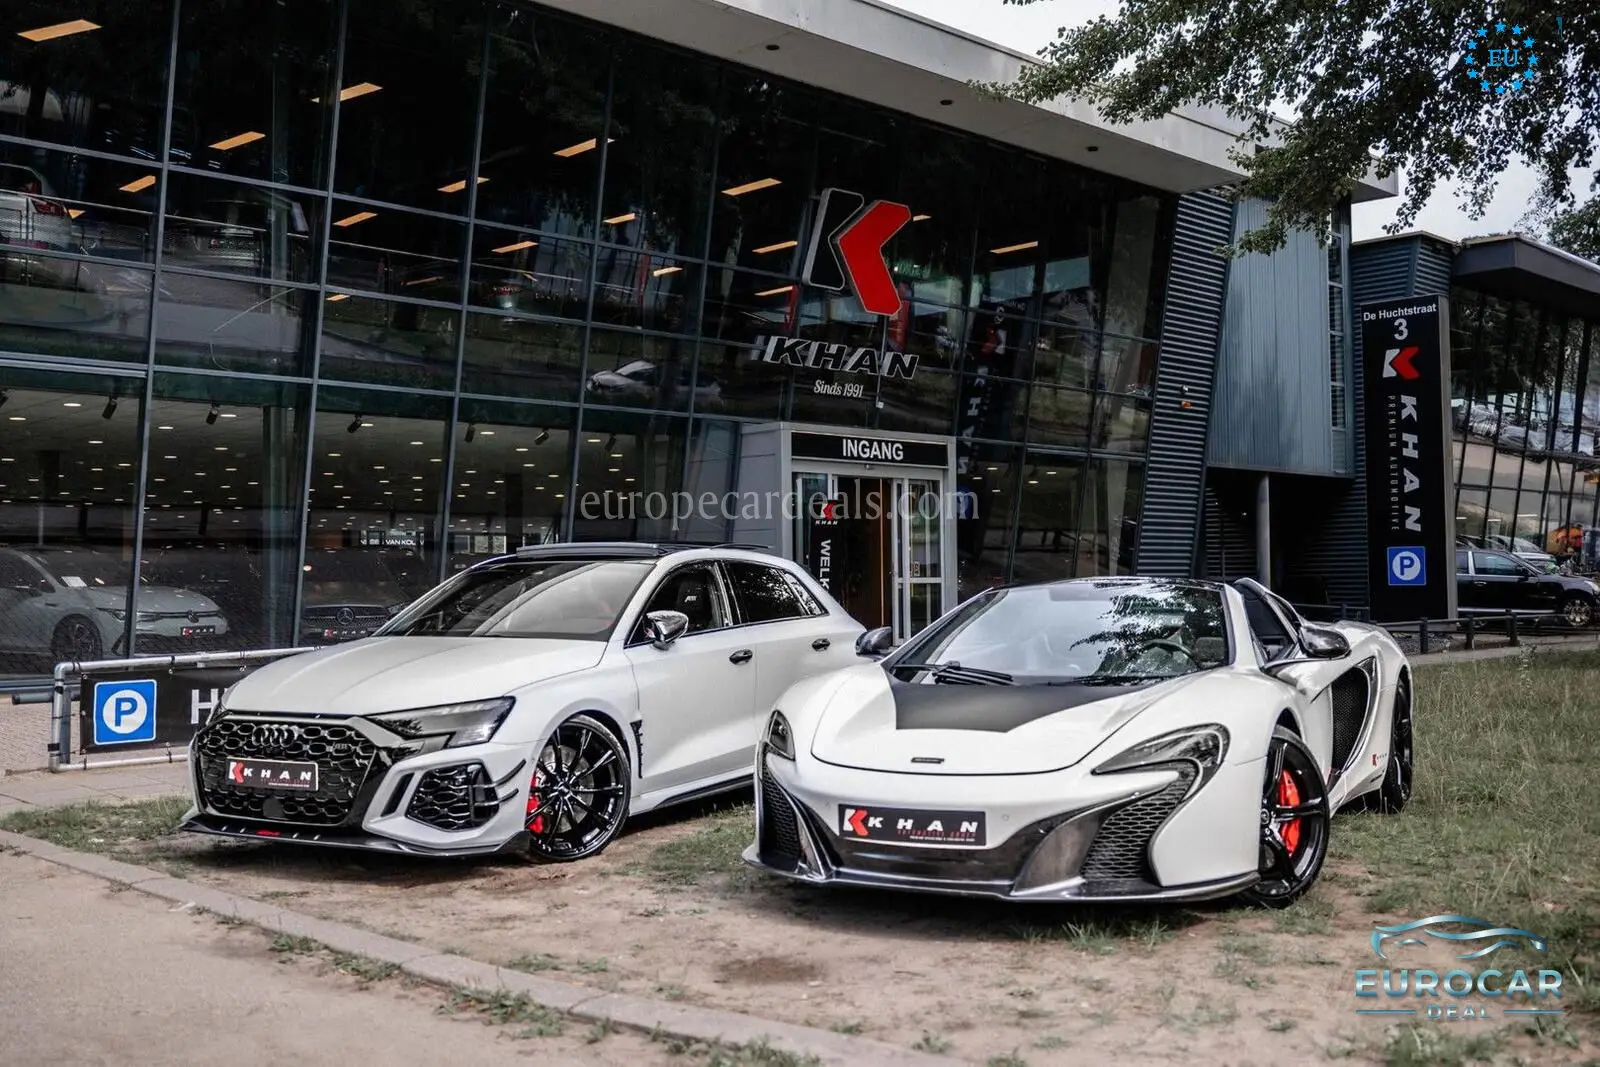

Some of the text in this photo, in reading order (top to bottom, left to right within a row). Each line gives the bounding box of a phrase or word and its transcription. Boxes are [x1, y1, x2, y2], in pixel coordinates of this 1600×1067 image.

[1363, 302, 1437, 321] De Huchtstraat
[1394, 318, 1408, 340] 3
[763, 335, 919, 379] KHAN
[813, 379, 864, 398] Sinds 1991
[1387, 395, 1397, 447] PREMIUM
[842, 439, 904, 460] INGANG
[1400, 394, 1422, 532] KHAN
[820, 539, 831, 590] WELK
[114, 697, 138, 727] P
[243, 767, 312, 781] KHAN
[867, 816, 978, 833] KHAN
